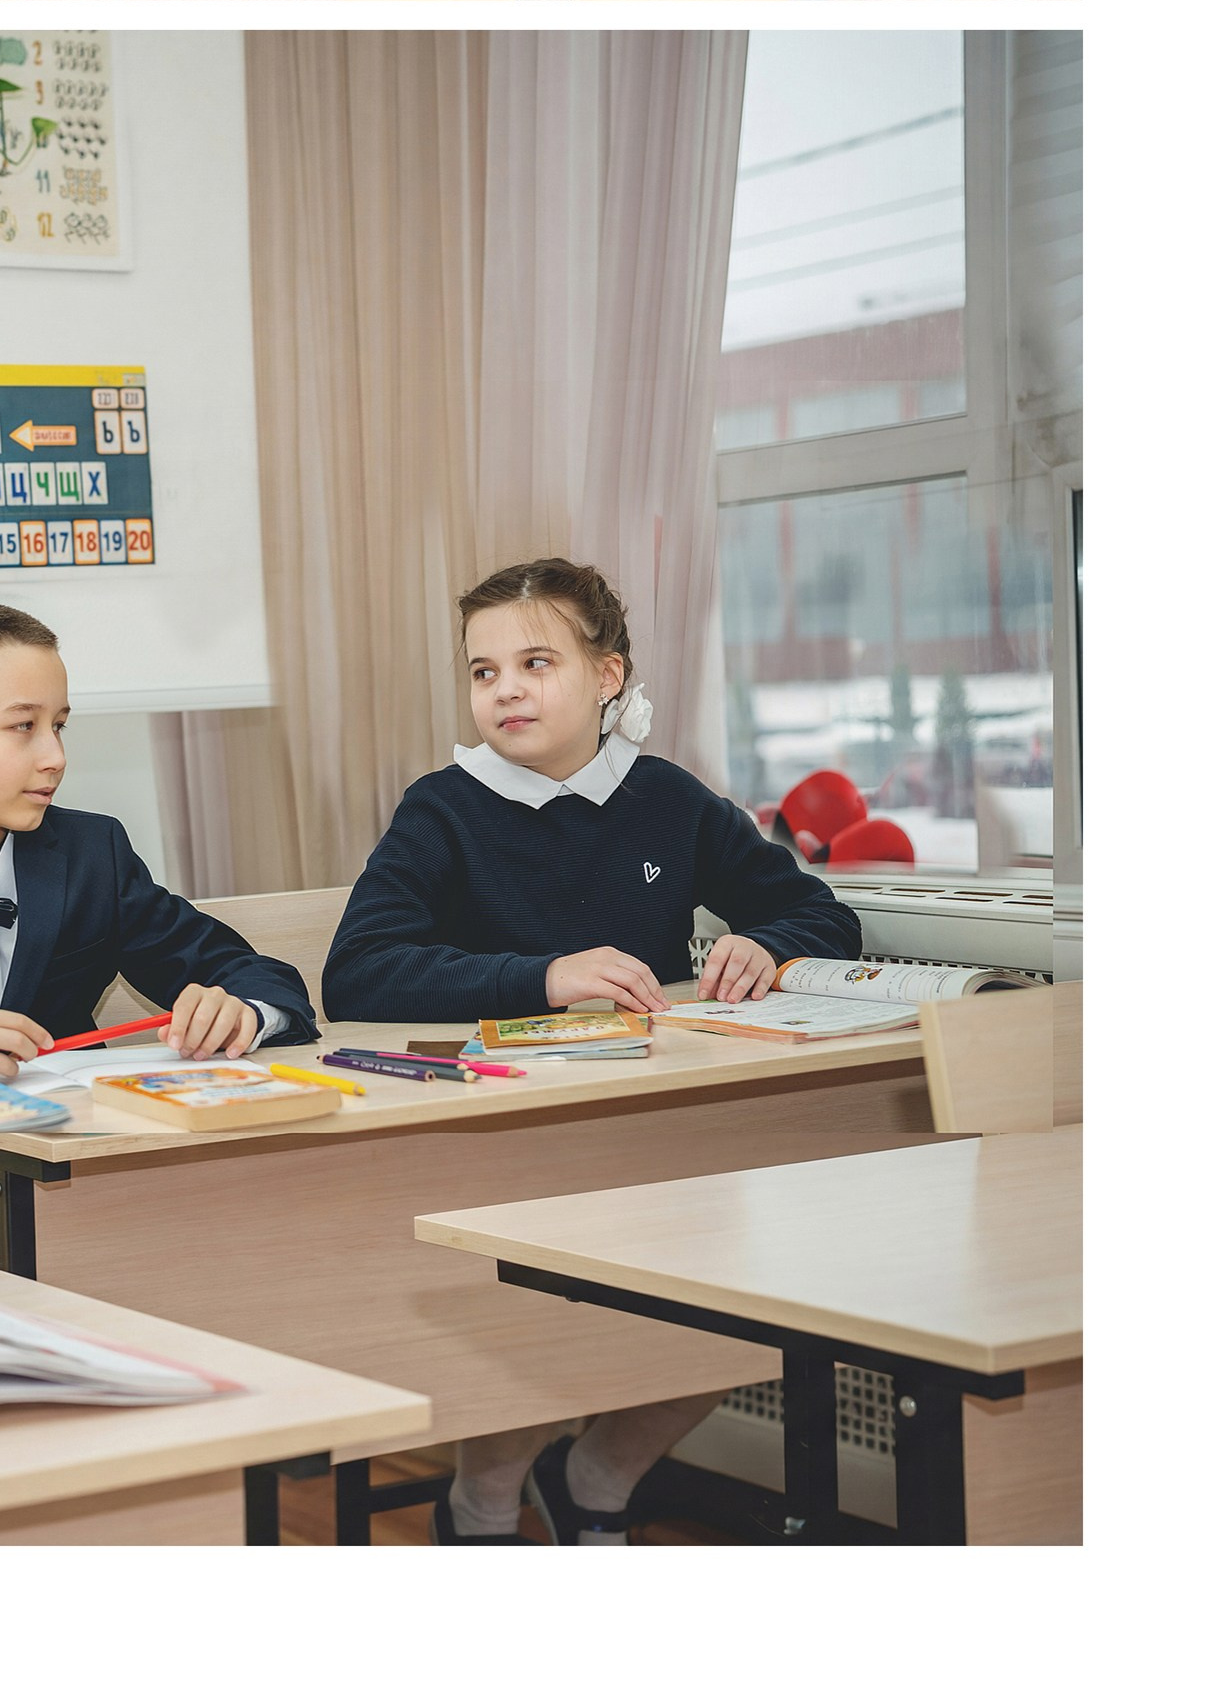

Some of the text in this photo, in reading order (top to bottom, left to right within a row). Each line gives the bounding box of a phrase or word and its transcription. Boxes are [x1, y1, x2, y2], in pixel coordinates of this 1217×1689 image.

[24, 533, 44, 553] 16
[50, 532, 68, 553] 17
[77, 531, 97, 552] 18
[103, 531, 122, 552] 19
[129, 530, 151, 551] 20
